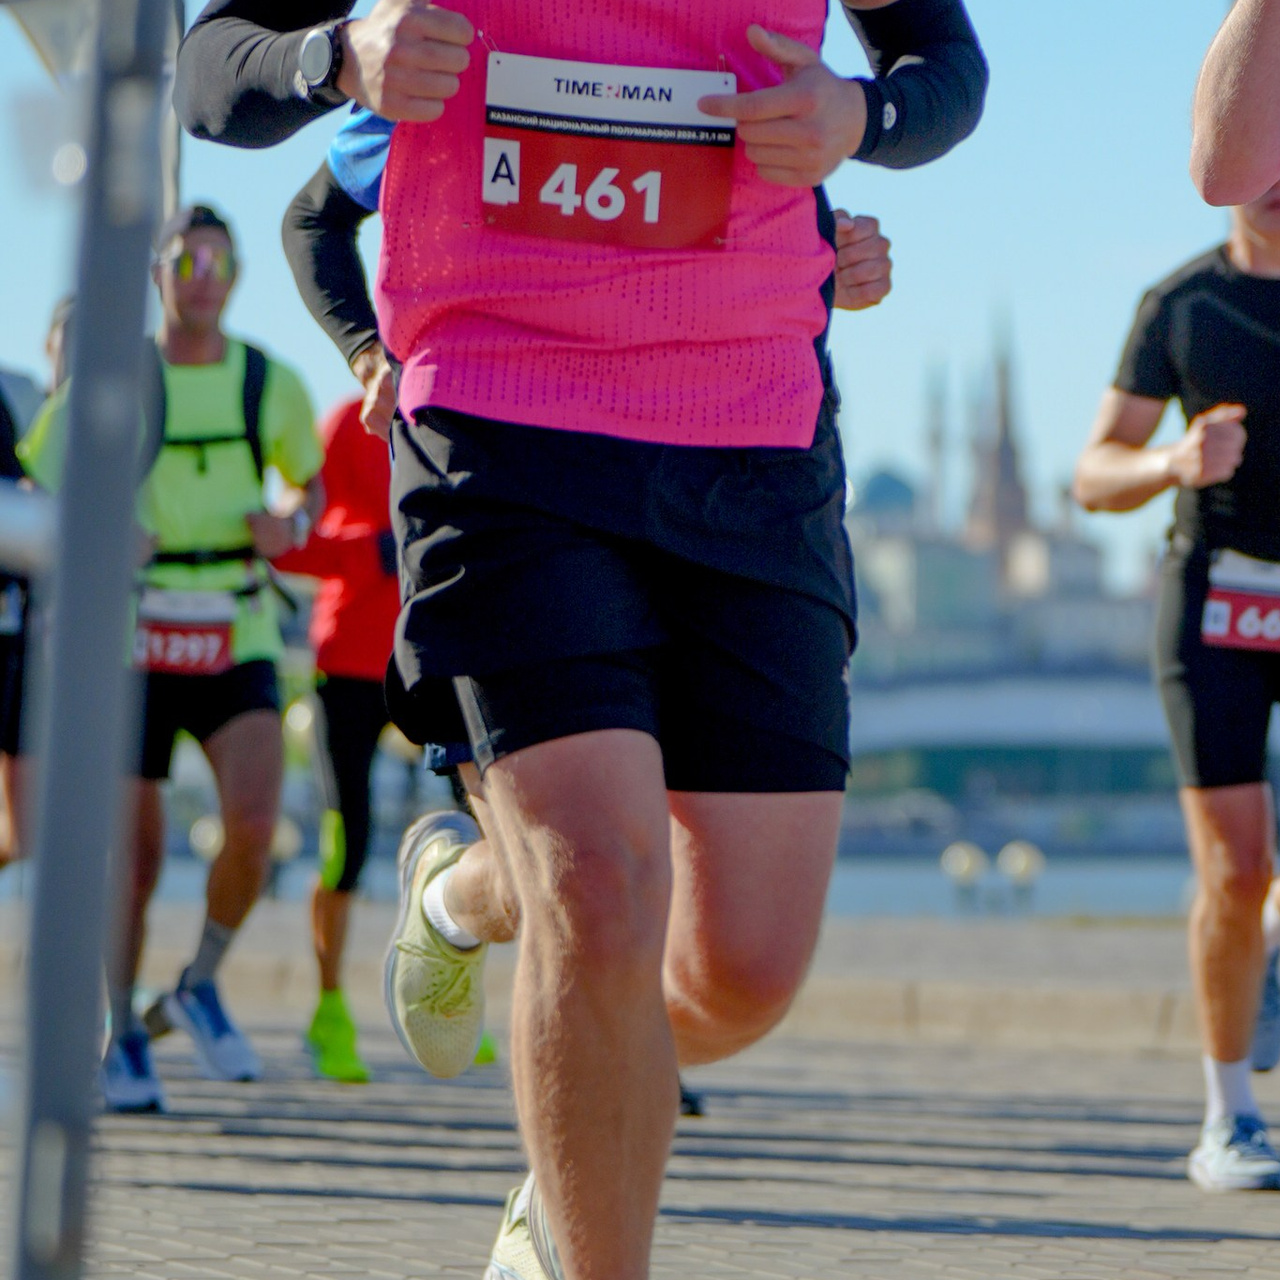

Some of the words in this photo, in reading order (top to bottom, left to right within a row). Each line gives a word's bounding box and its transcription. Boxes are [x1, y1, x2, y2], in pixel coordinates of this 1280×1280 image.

[490, 110, 538, 126] КАЗАНСКИЙ
[539, 118, 610, 134] НАЦИОНАЛЬНЫЙ
[611, 125, 676, 139] ПОЛУМАРАФОН
[491, 152, 516, 186] A
[539, 162, 662, 224] 461
